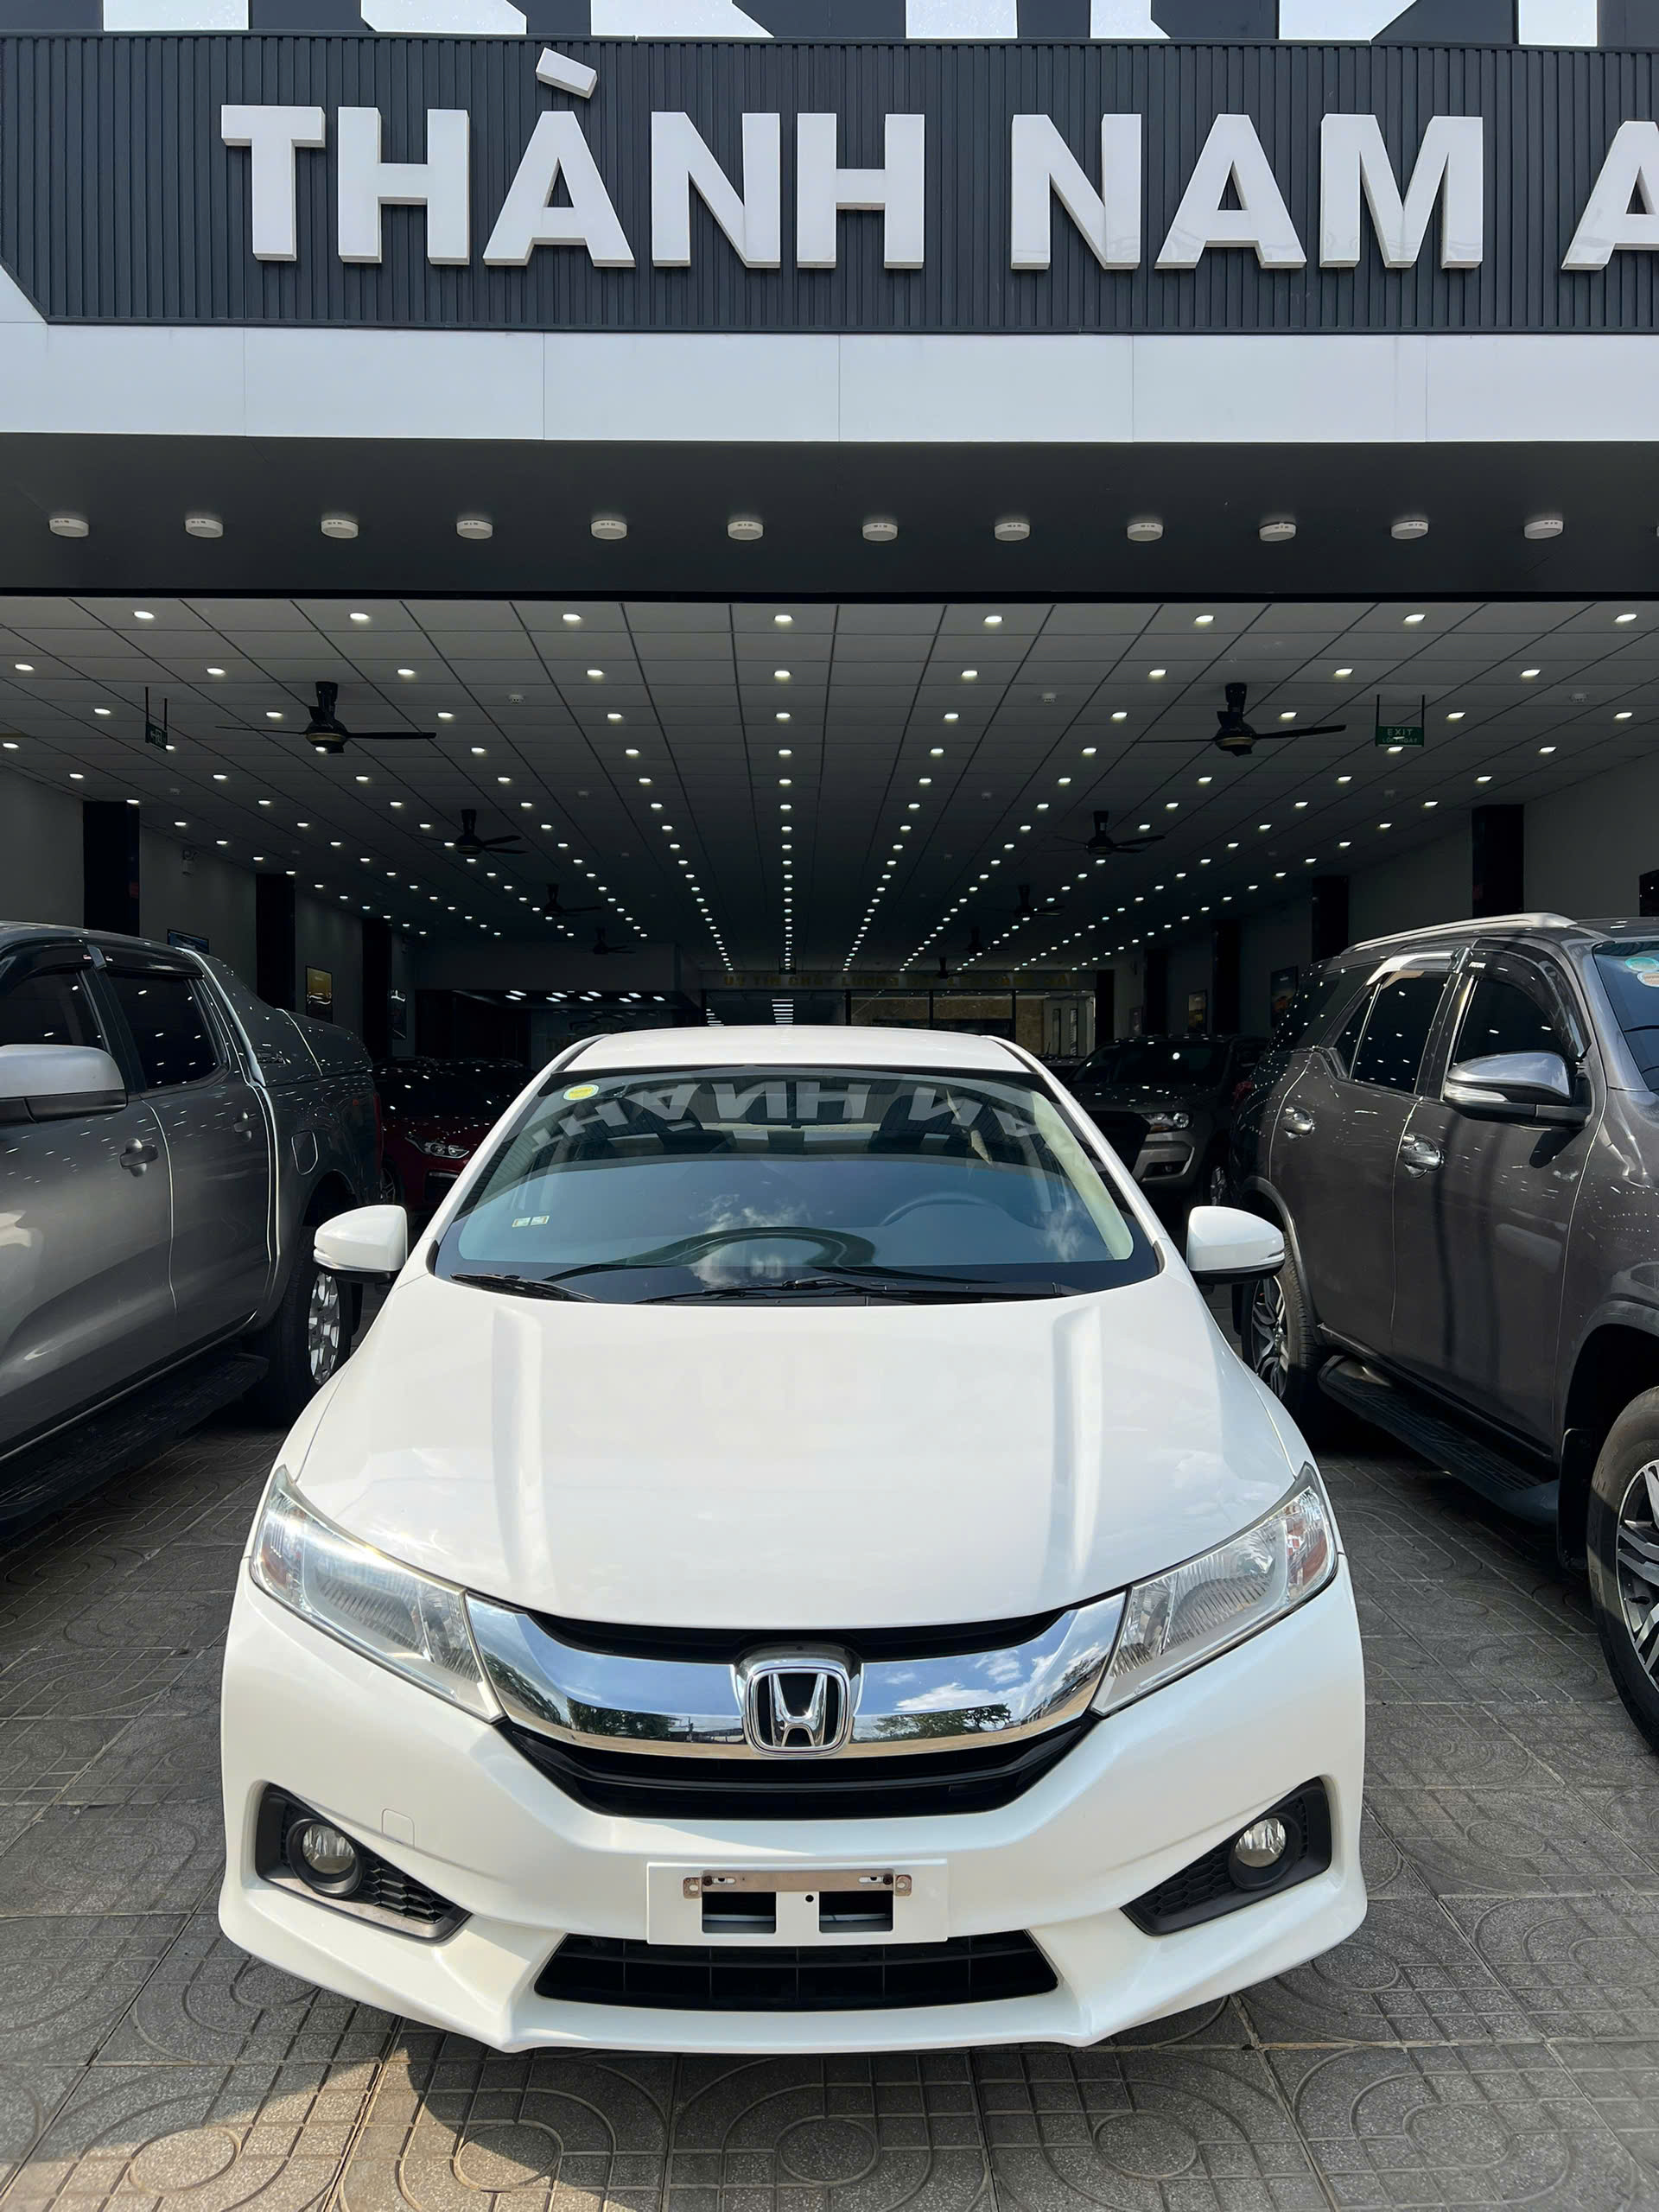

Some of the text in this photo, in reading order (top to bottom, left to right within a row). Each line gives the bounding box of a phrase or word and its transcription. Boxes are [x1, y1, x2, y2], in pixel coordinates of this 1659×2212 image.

[220, 47, 925, 270] THÀNH
[1011, 113, 1484, 270] NAM
[1387, 728, 1413, 736] EXIT
